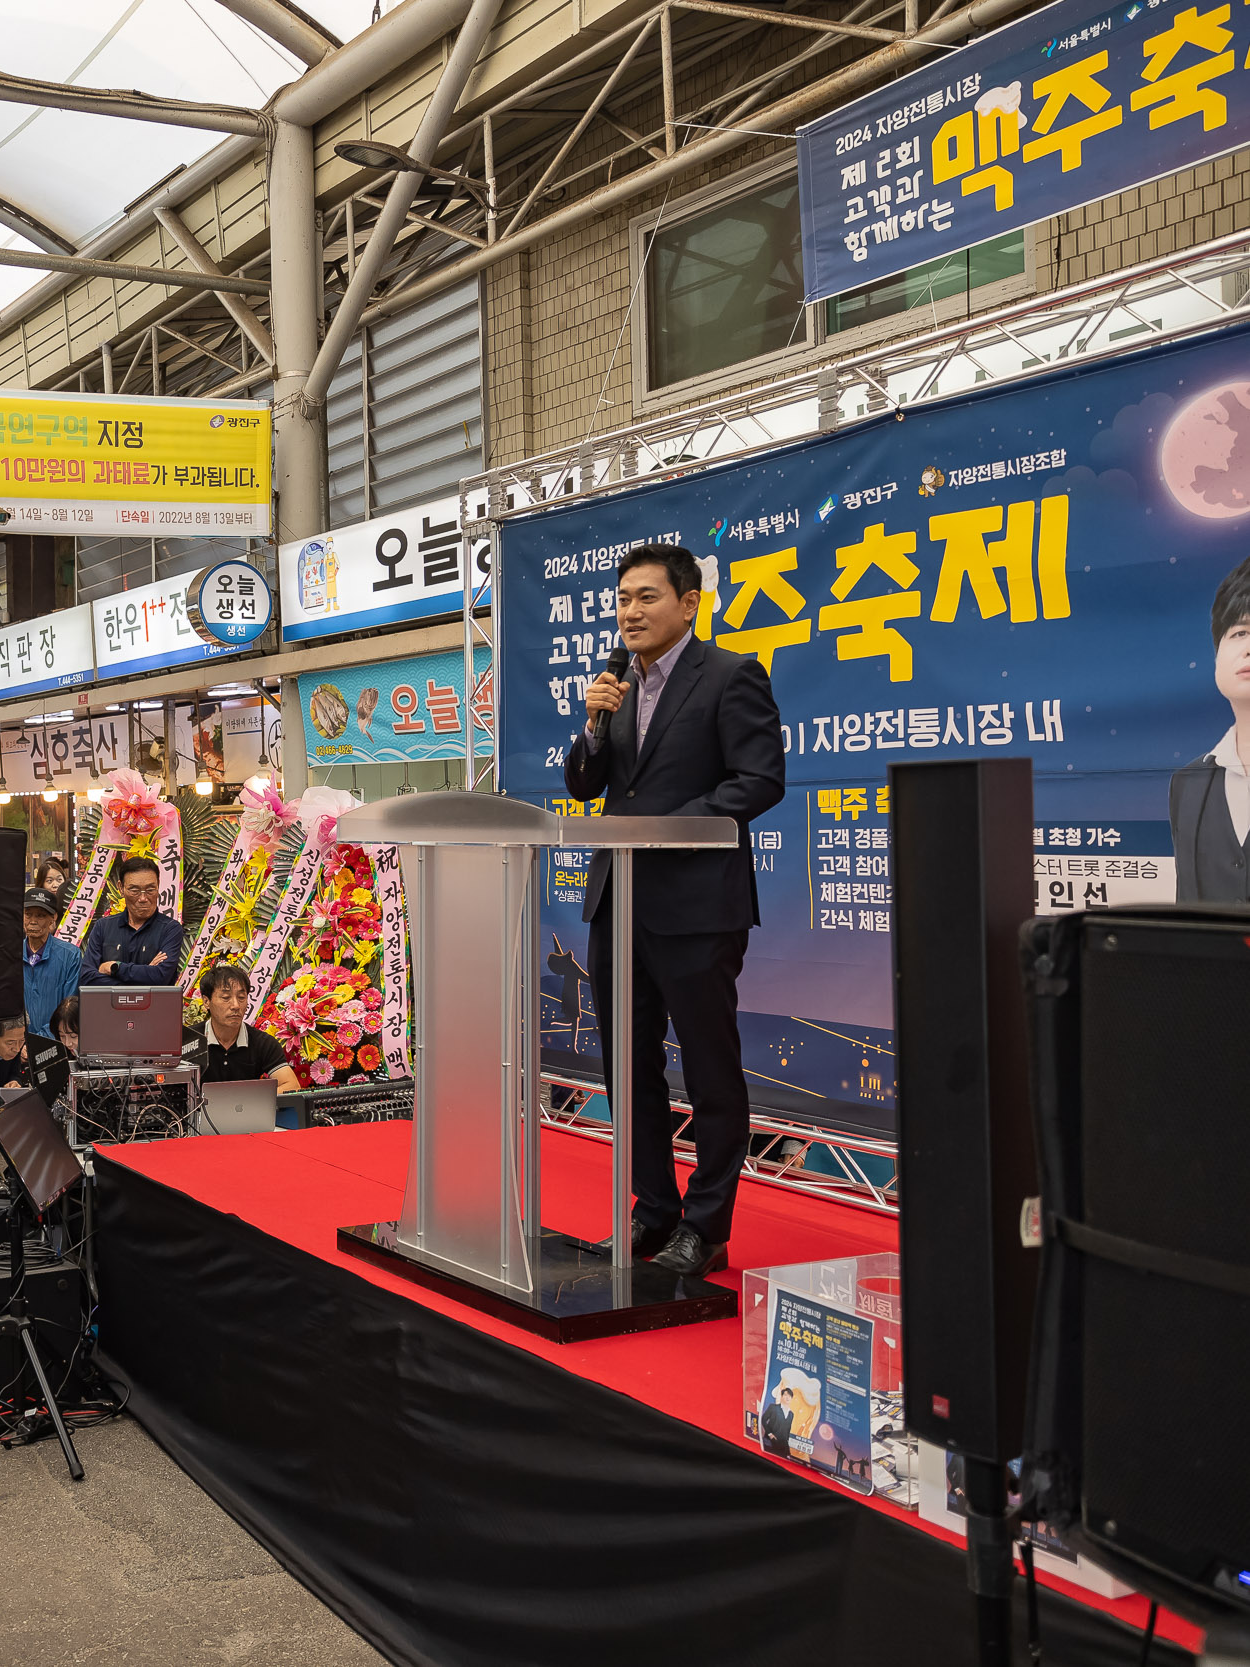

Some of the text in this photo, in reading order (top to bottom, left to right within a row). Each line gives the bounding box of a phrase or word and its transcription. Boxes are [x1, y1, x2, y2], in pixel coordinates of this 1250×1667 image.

[1058, 17, 1112, 50] 서울특별시
[835, 72, 982, 156] 2024 자양전통시장
[931, 2, 1250, 212] 맥주축
[841, 160, 867, 191] 제
[844, 170, 925, 224] 고객과
[843, 199, 956, 263] 함께하는
[97, 419, 144, 448] 지정
[226, 416, 262, 429] 광진구
[0, 456, 86, 484] 10만원의
[93, 460, 168, 487] 과태료가
[174, 464, 260, 489] 부과됩니다.
[948, 448, 1067, 488] 자양전통시장조합
[842, 482, 899, 511] 광진구
[71, 508, 94, 522] 12일
[121, 510, 253, 526] 단속일 2022년 8월 13일부터
[728, 509, 800, 542] 서울특별시
[544, 553, 579, 579] 2024
[215, 574, 256, 596] 오늘
[215, 598, 256, 620] 생선
[549, 594, 573, 623] 제
[226, 625, 246, 637] 생선
[57, 672, 84, 687] T.444-5351
[812, 703, 1015, 754] 자양전통시장
[1025, 699, 1065, 742] 내
[30, 721, 118, 780] 삼호축산
[818, 787, 869, 821] 맥주
[817, 828, 850, 850] 고객
[1048, 827, 1082, 846] 초청
[1086, 827, 1121, 847] 가수
[160, 839, 181, 881] 축
[376, 846, 399, 874] 祝
[554, 852, 583, 868] 이틀간
[818, 854, 888, 876] 고객 참여
[1067, 859, 1100, 877] 트롯
[1105, 860, 1159, 879] 준결승
[264, 849, 321, 961] 신성전통시장
[820, 909, 890, 933] 간식 체험
[383, 880, 407, 1038] 자양전통시장
[118, 995, 144, 1003] ELF
[35, 1045, 58, 1065] SHURE
